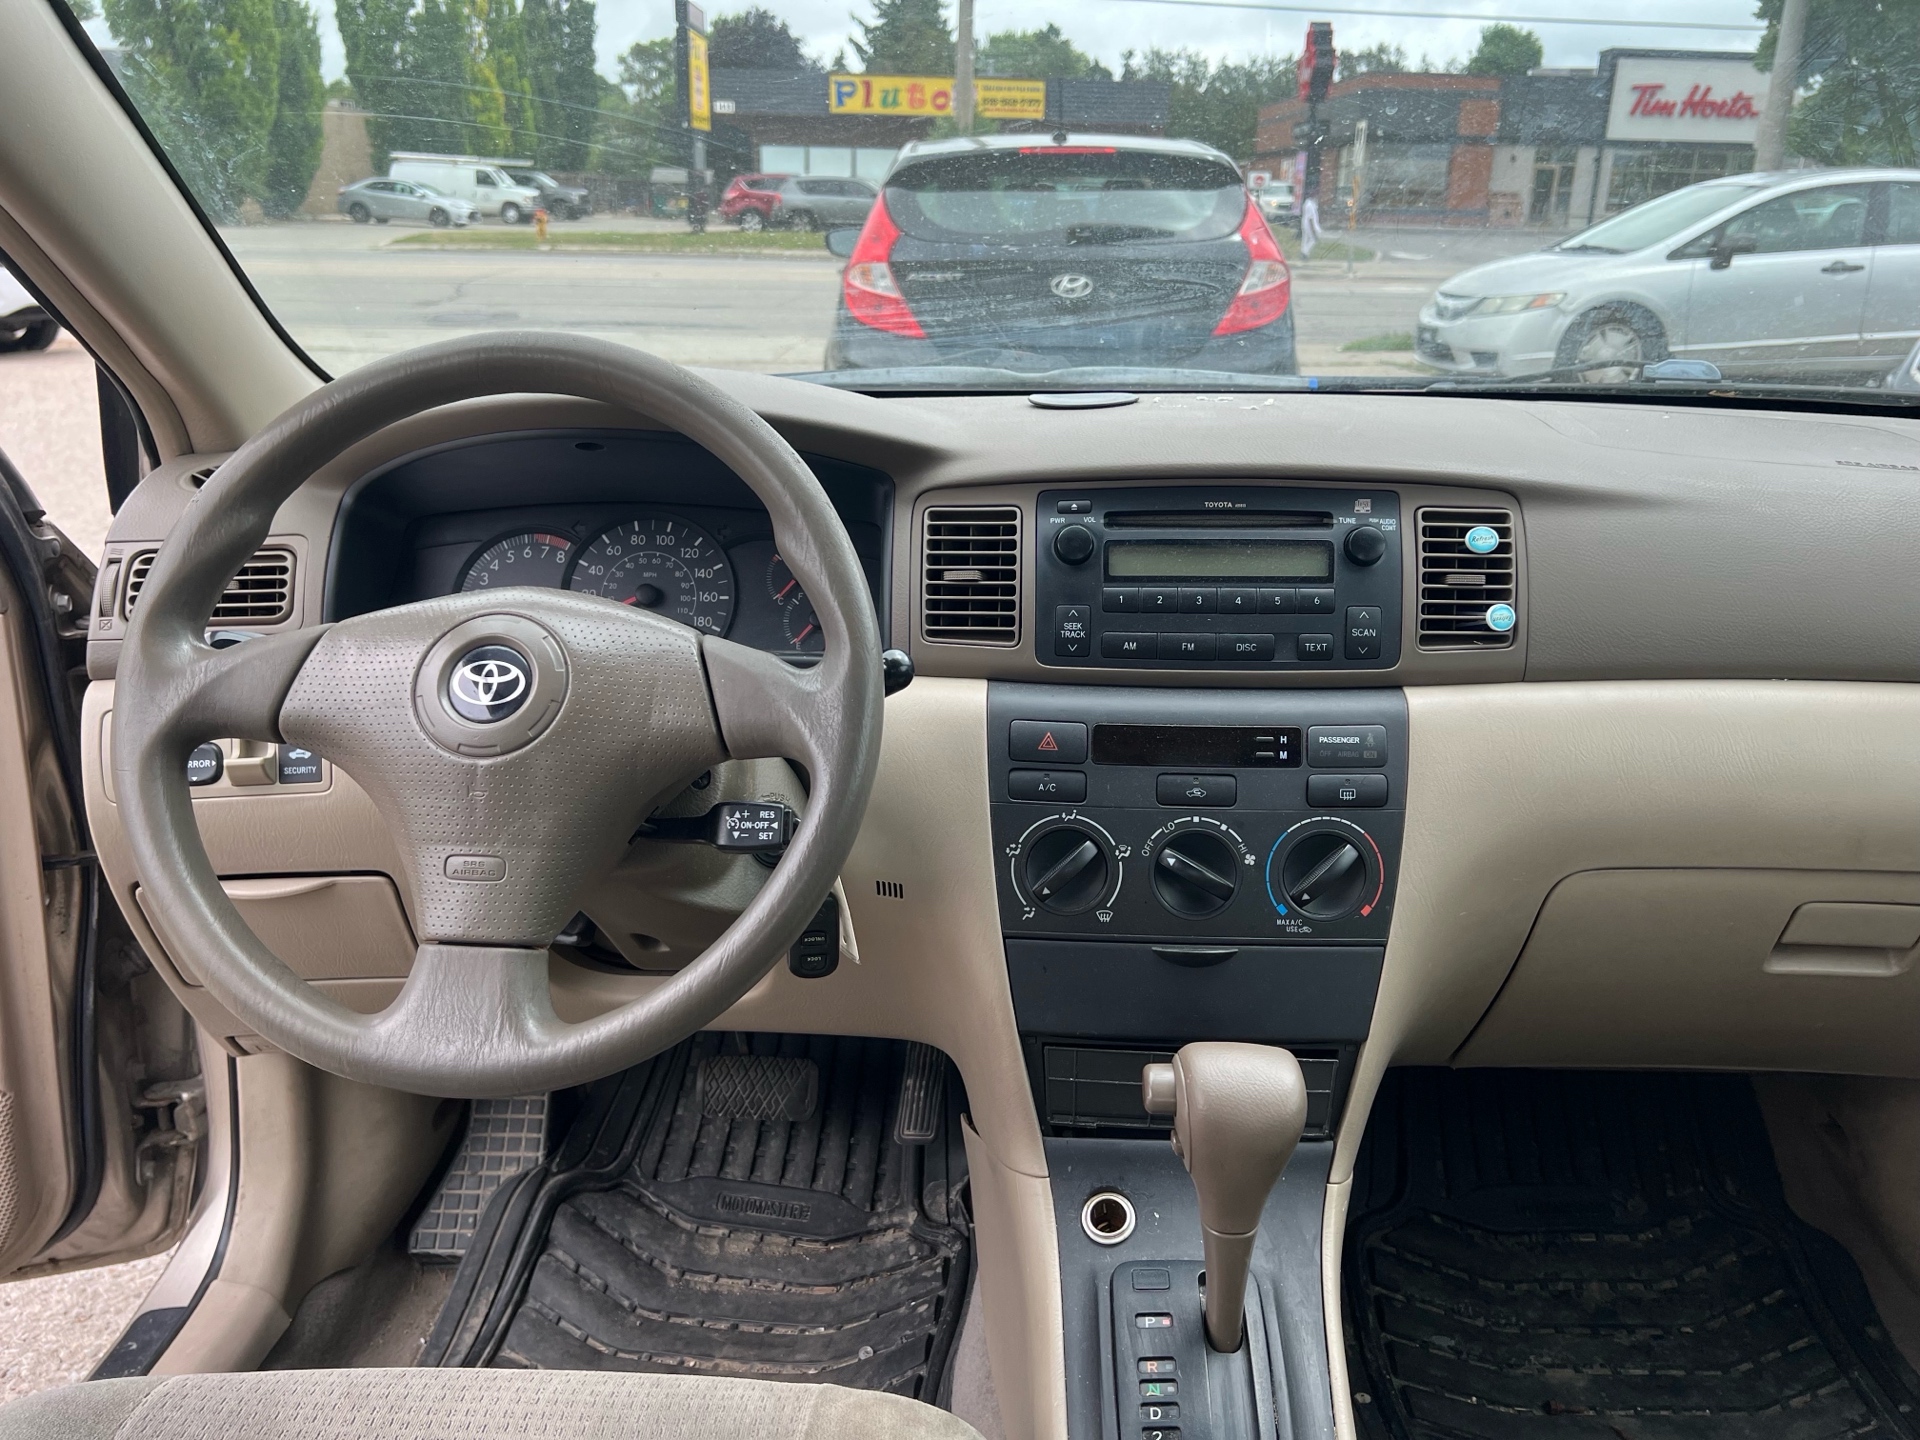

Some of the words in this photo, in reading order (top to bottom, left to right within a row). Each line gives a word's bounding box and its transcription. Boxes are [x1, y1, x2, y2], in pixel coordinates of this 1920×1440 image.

[1630, 84, 1677, 116] Tim
[1680, 84, 1760, 118] Horto
[630, 535, 646, 545] 80
[656, 535, 675, 546] 100
[523, 546, 532, 558] 6
[541, 546, 550, 558] 7
[606, 545, 622, 556] 60
[680, 548, 699, 559] 120
[505, 550, 515, 563] 5
[556, 551, 565, 563] 8
[638, 557, 648, 565] 50
[652, 557, 661, 565] 60
[490, 559, 499, 571] 4
[588, 565, 604, 576] 40
[694, 568, 713, 579] 140
[479, 572, 489, 585] 3
[608, 582, 617, 590] 20
[699, 591, 718, 602] 160
[777, 597, 784, 605] C
[798, 592, 804, 600] F
[1157, 596, 1163, 604] 2
[1196, 596, 1202, 604] 3
[1275, 597, 1281, 605] 5
[1314, 597, 1320, 605] 6
[693, 616, 713, 627] 180
[1351, 629, 1376, 637] SCAN
[796, 642, 802, 650] E
[1123, 642, 1137, 650] AM
[1182, 643, 1195, 651] FM
[1236, 643, 1257, 652] DISC
[1304, 643, 1328, 652] TEXT
[1280, 735, 1287, 744] H
[1319, 736, 1360, 744] PASSENGER
[1279, 750, 1288, 760] M
[187, 759, 211, 769] RROR
[283, 766, 317, 775] SECURITY
[1038, 783, 1057, 792] A/C
[759, 810, 776, 819] RES
[740, 821, 770, 829] ON-OFF
[1162, 822, 1176, 833] LO
[758, 832, 774, 840] SET
[1141, 838, 1154, 857] OFF
[1237, 843, 1249, 854] HI
[462, 860, 486, 868] SRS
[452, 869, 496, 877] AIRBAG
[1145, 1317, 1155, 1328] P
[1147, 1362, 1158, 1373] R
[1149, 1383, 1161, 1394] N
[1150, 1407, 1161, 1420] D
[1152, 1430, 1163, 1440] 2
